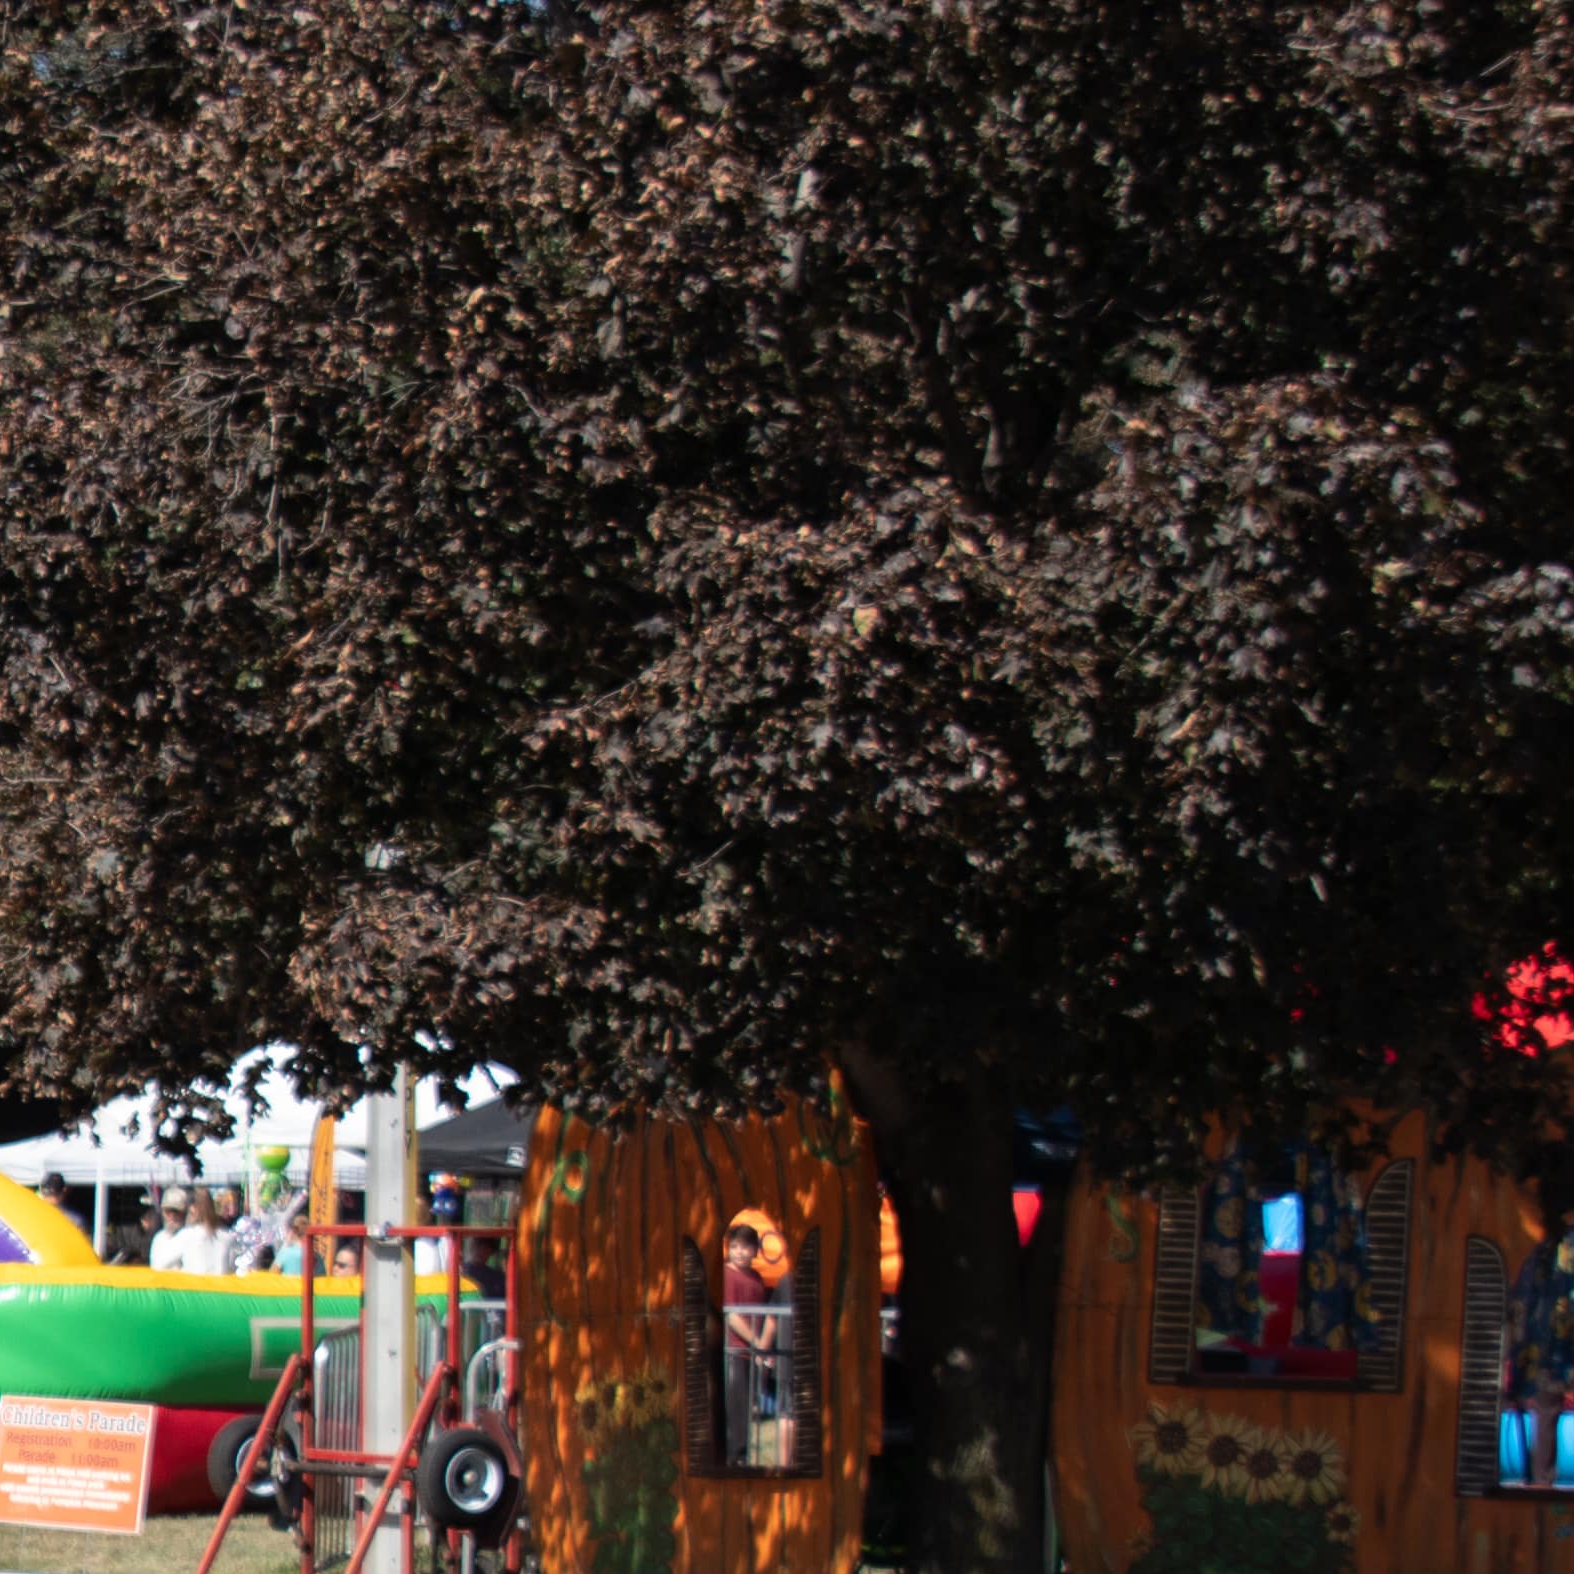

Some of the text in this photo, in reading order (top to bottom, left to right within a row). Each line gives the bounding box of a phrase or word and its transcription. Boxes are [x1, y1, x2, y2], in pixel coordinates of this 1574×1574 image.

[3, 1405, 146, 1433] Children's Parade
[6, 1431, 72, 1447] Registration
[19, 1449, 56, 1464] Parade
